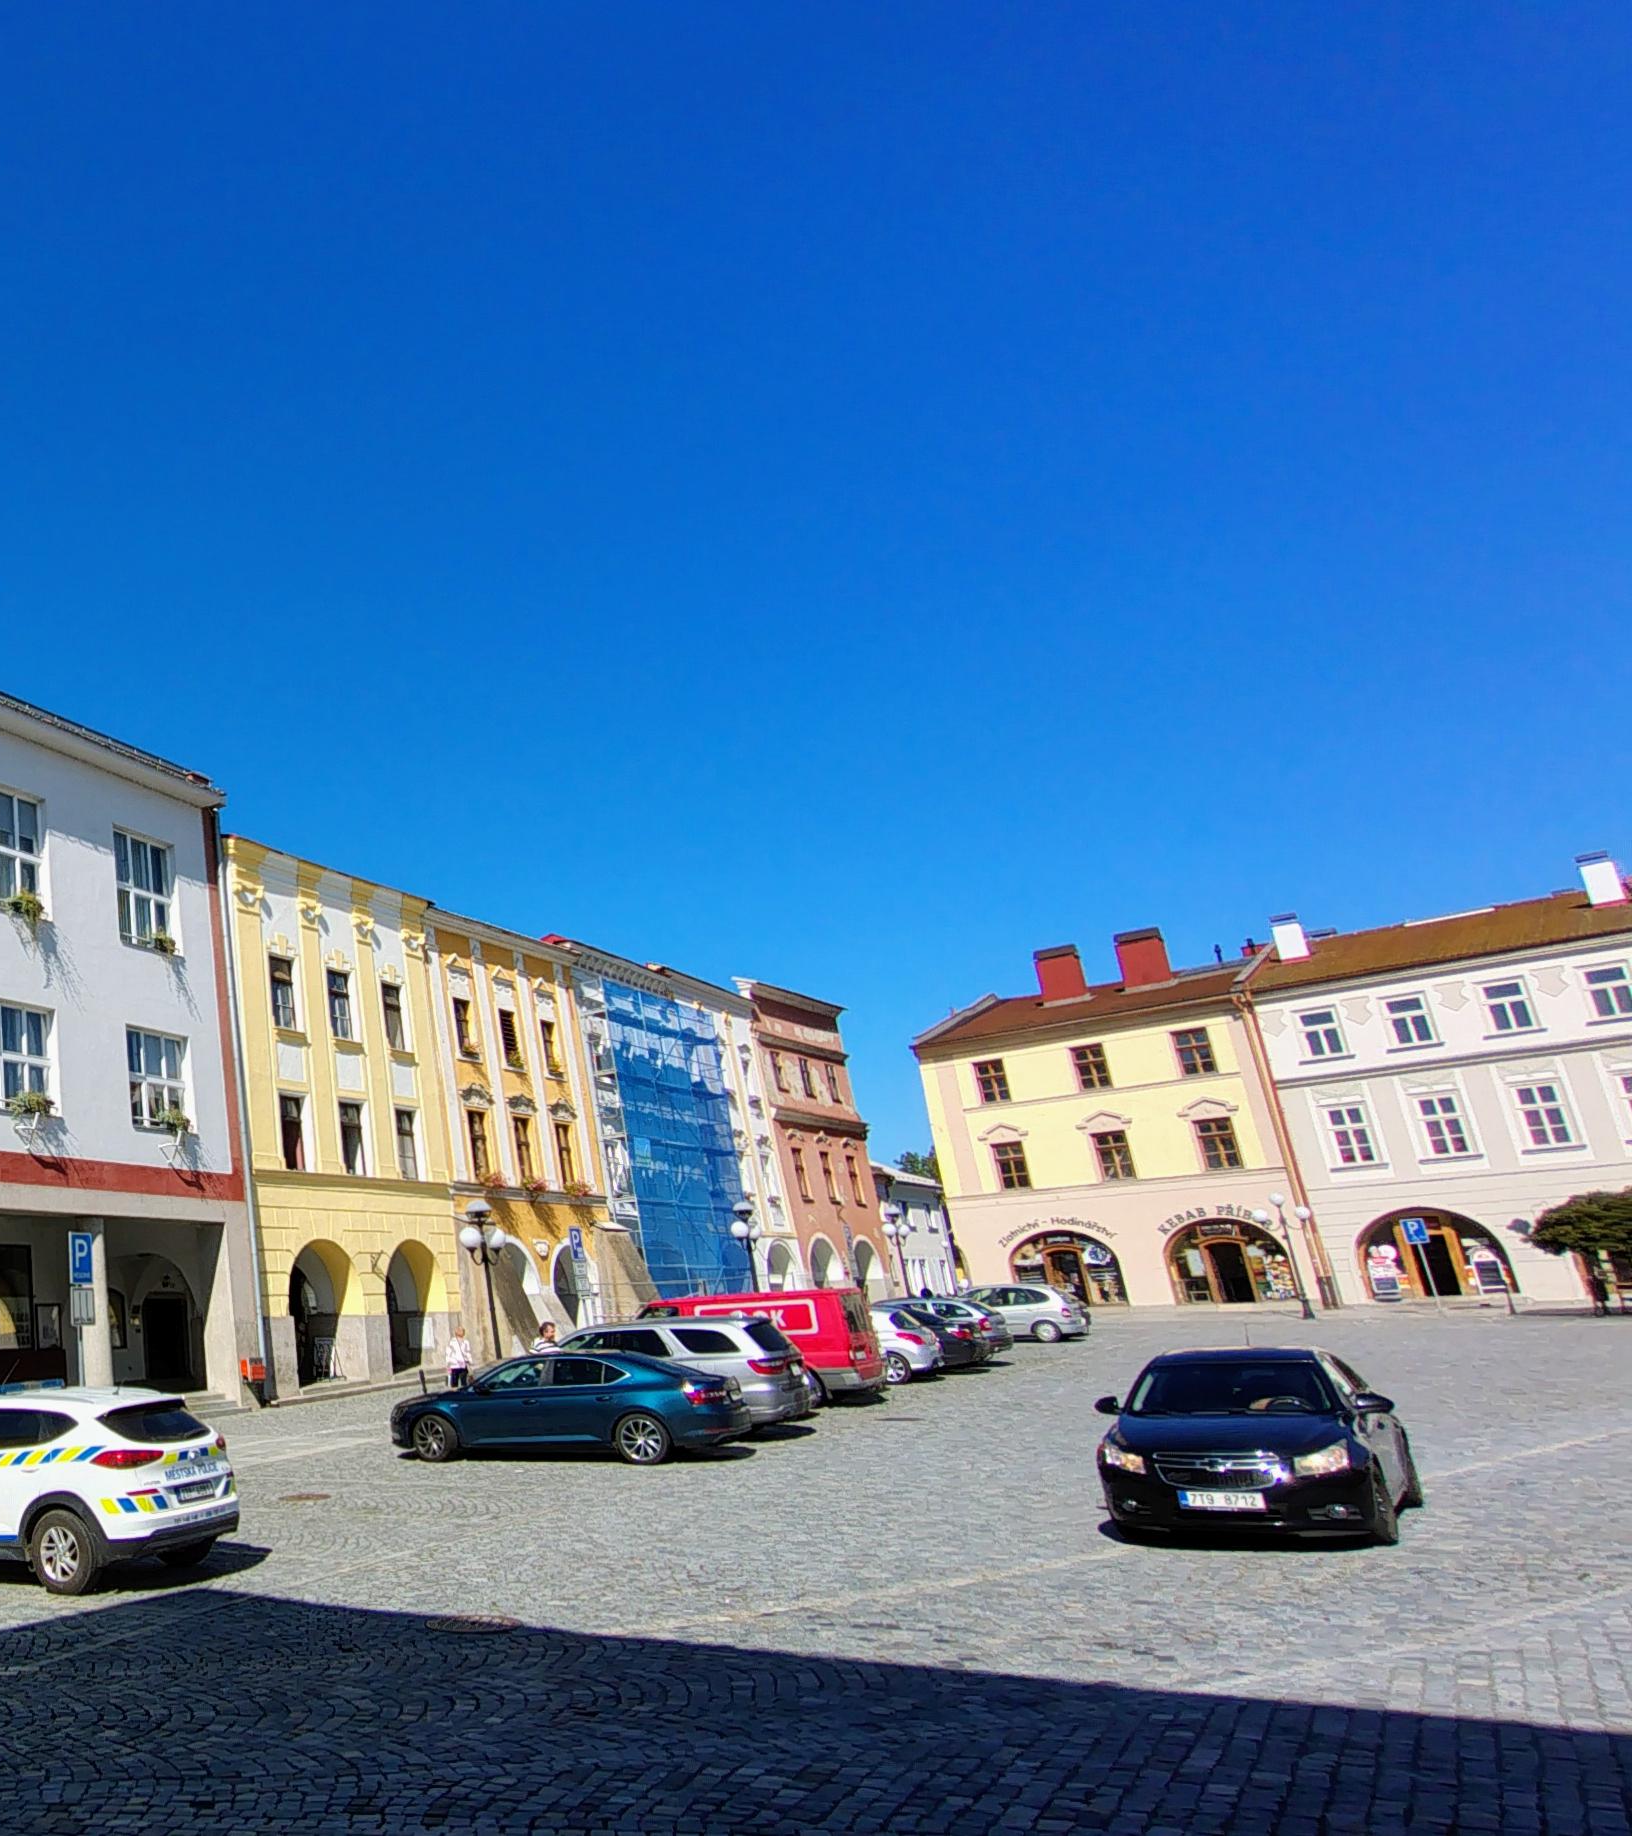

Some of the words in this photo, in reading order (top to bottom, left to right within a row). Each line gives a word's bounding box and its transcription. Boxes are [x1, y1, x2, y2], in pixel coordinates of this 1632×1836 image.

[1050, 1215, 1119, 1240] Hodinářství
[1157, 1206, 1208, 1236] KEBAB
[1215, 1203, 1274, 1232] PŘÍBR
[572, 1231, 579, 1249] P
[74, 1238, 88, 1268] P
[165, 1465, 196, 1480] MĚSTSKÁ
[196, 1461, 219, 1476] POLICIE
[1189, 1493, 1215, 1505] 7T9
[1223, 1494, 1257, 1507] 8712
